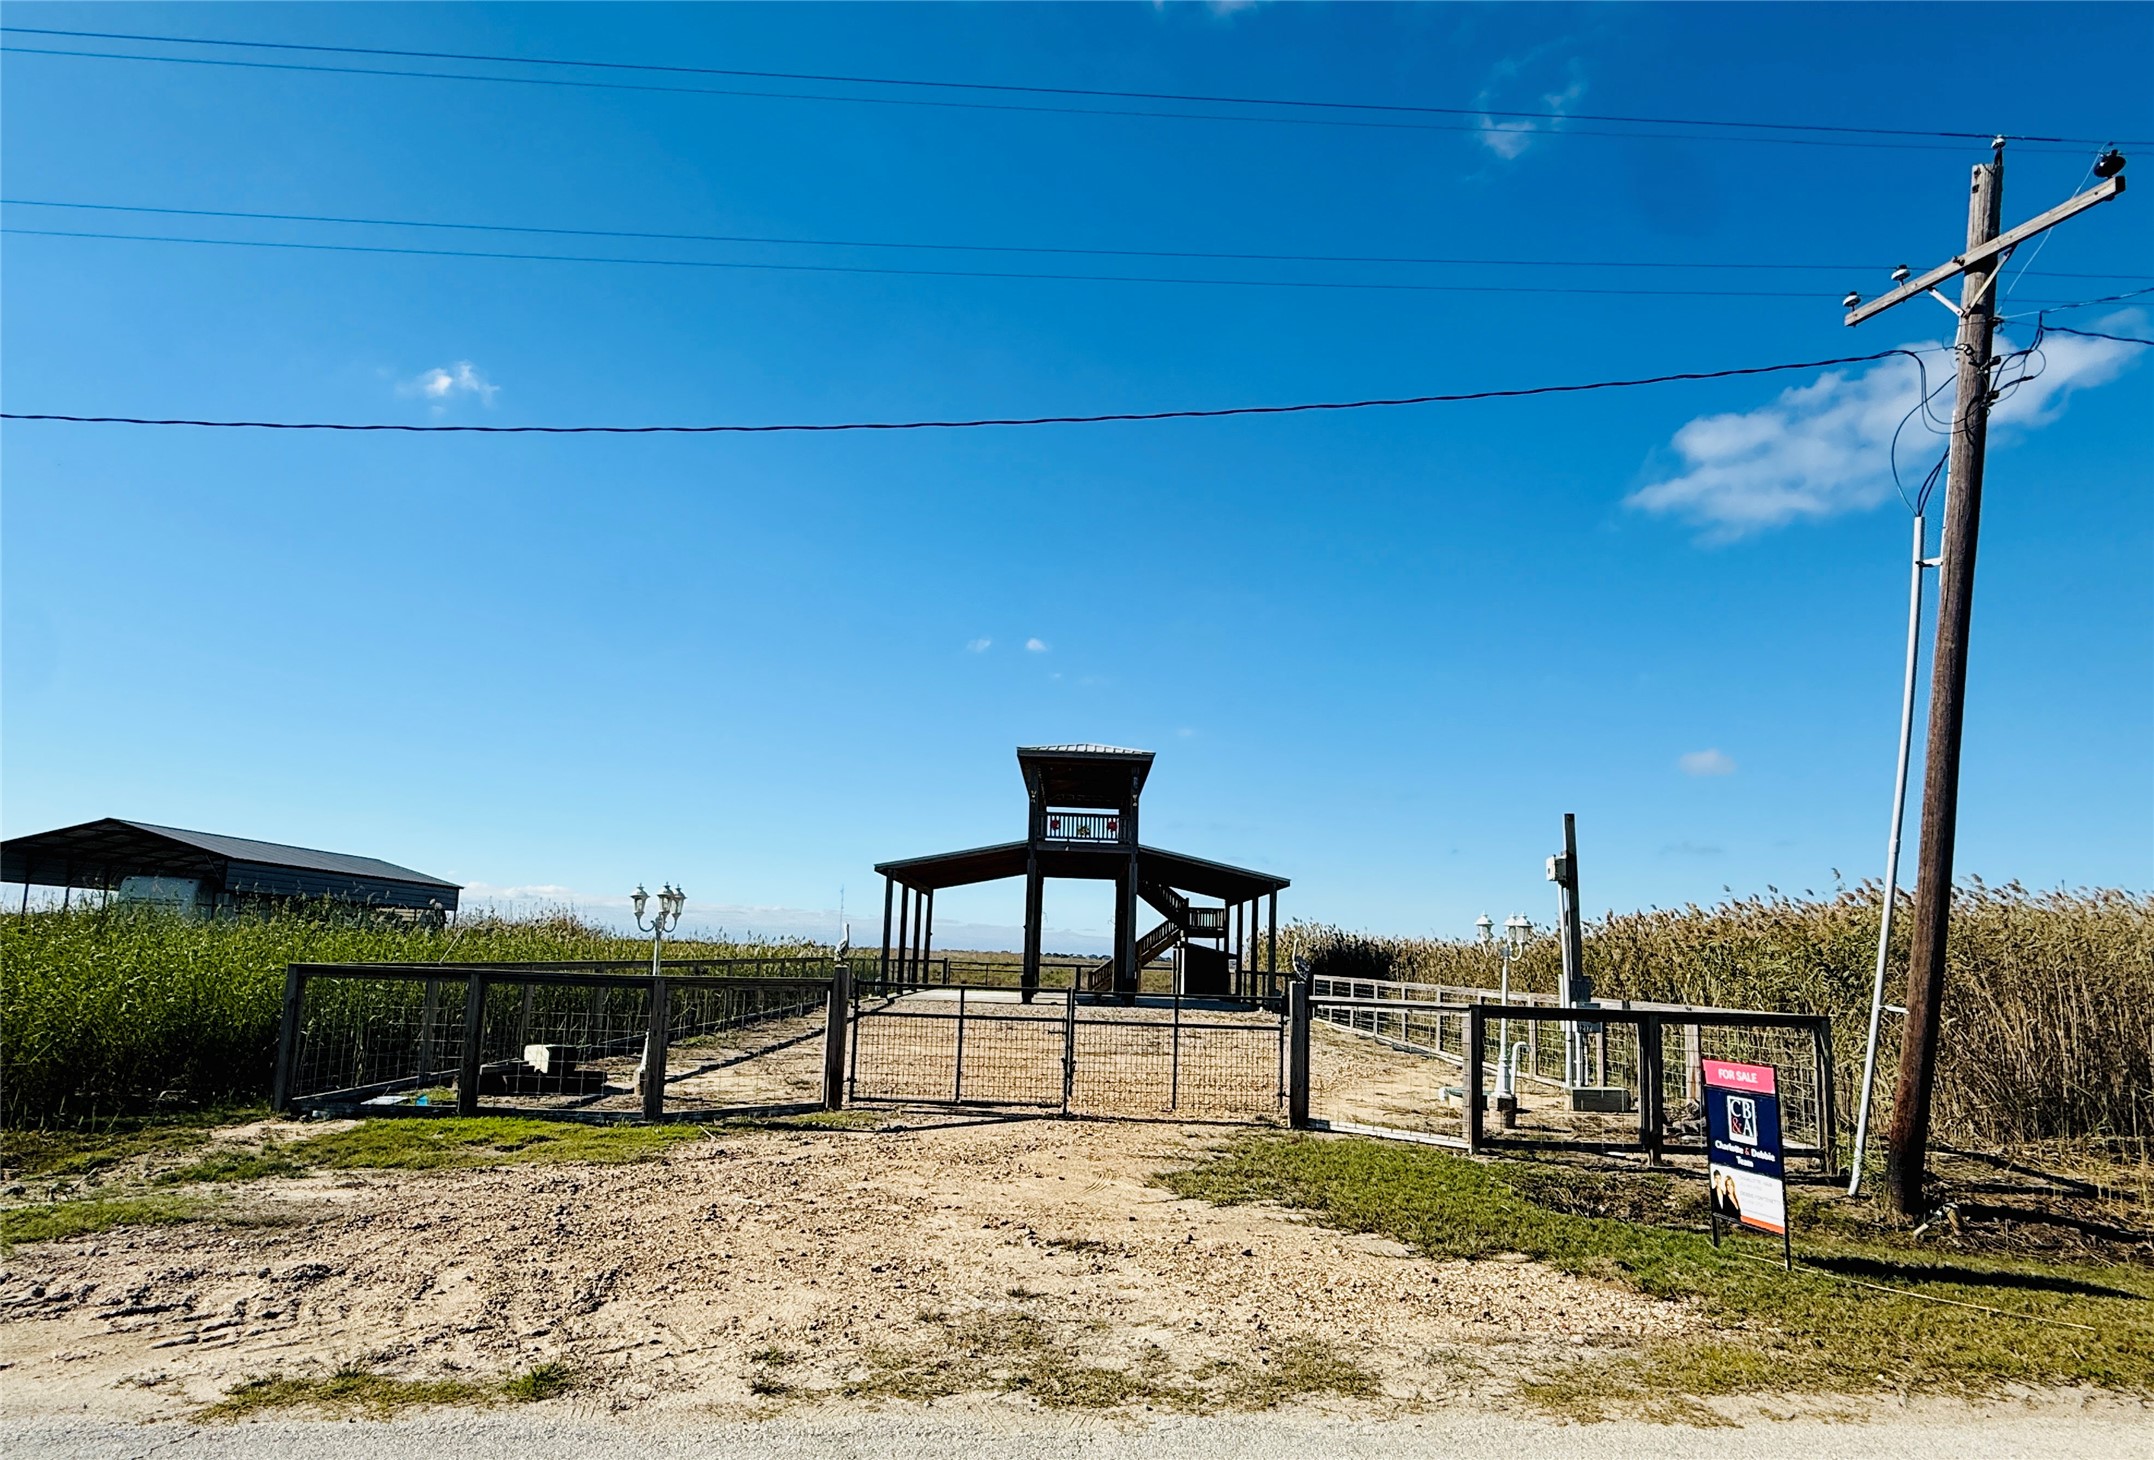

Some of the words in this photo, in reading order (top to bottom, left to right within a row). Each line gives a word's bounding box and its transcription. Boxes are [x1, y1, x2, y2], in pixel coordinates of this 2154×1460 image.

[1718, 1068, 1735, 1080] FOR
[1736, 1071, 1758, 1083] SALE
[1715, 1140, 1744, 1154] Charlotte
[1751, 1148, 1776, 1162] Debbie
[1736, 1156, 1754, 1168] Team
